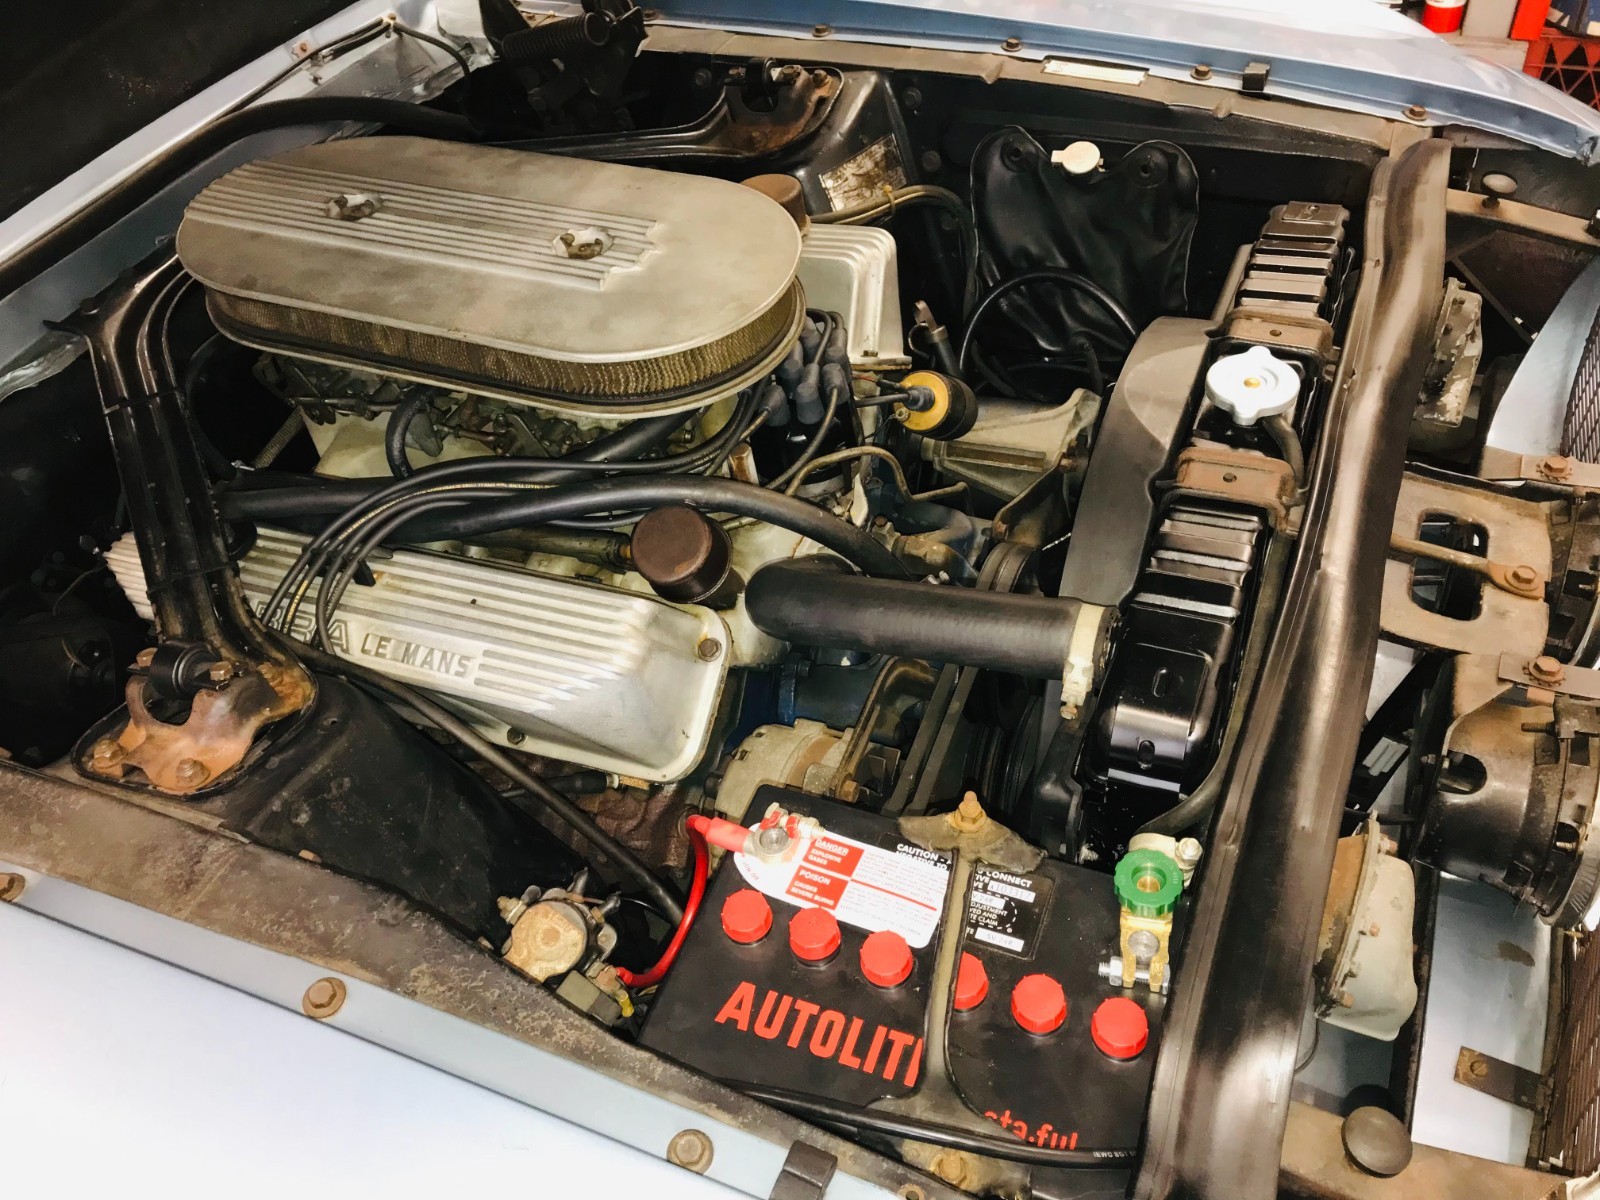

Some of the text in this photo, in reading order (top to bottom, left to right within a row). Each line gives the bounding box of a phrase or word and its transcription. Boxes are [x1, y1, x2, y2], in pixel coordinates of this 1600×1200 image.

[360, 633, 393, 658] LE
[400, 642, 476, 679] MANS
[815, 838, 849, 856] DANGER
[896, 843, 939, 862] CAUTION
[808, 854, 828, 866] GASES
[811, 848, 842, 863] EXPLOSIVE
[799, 869, 831, 886] POISON
[986, 870, 1032, 888] CONNECT
[794, 880, 818, 893] CAUSES
[790, 886, 835, 906] SEVERE BURNS
[970, 902, 1008, 917] DJUSTMENT
[982, 911, 998, 920] AND
[978, 916, 998, 926] CLAIM
